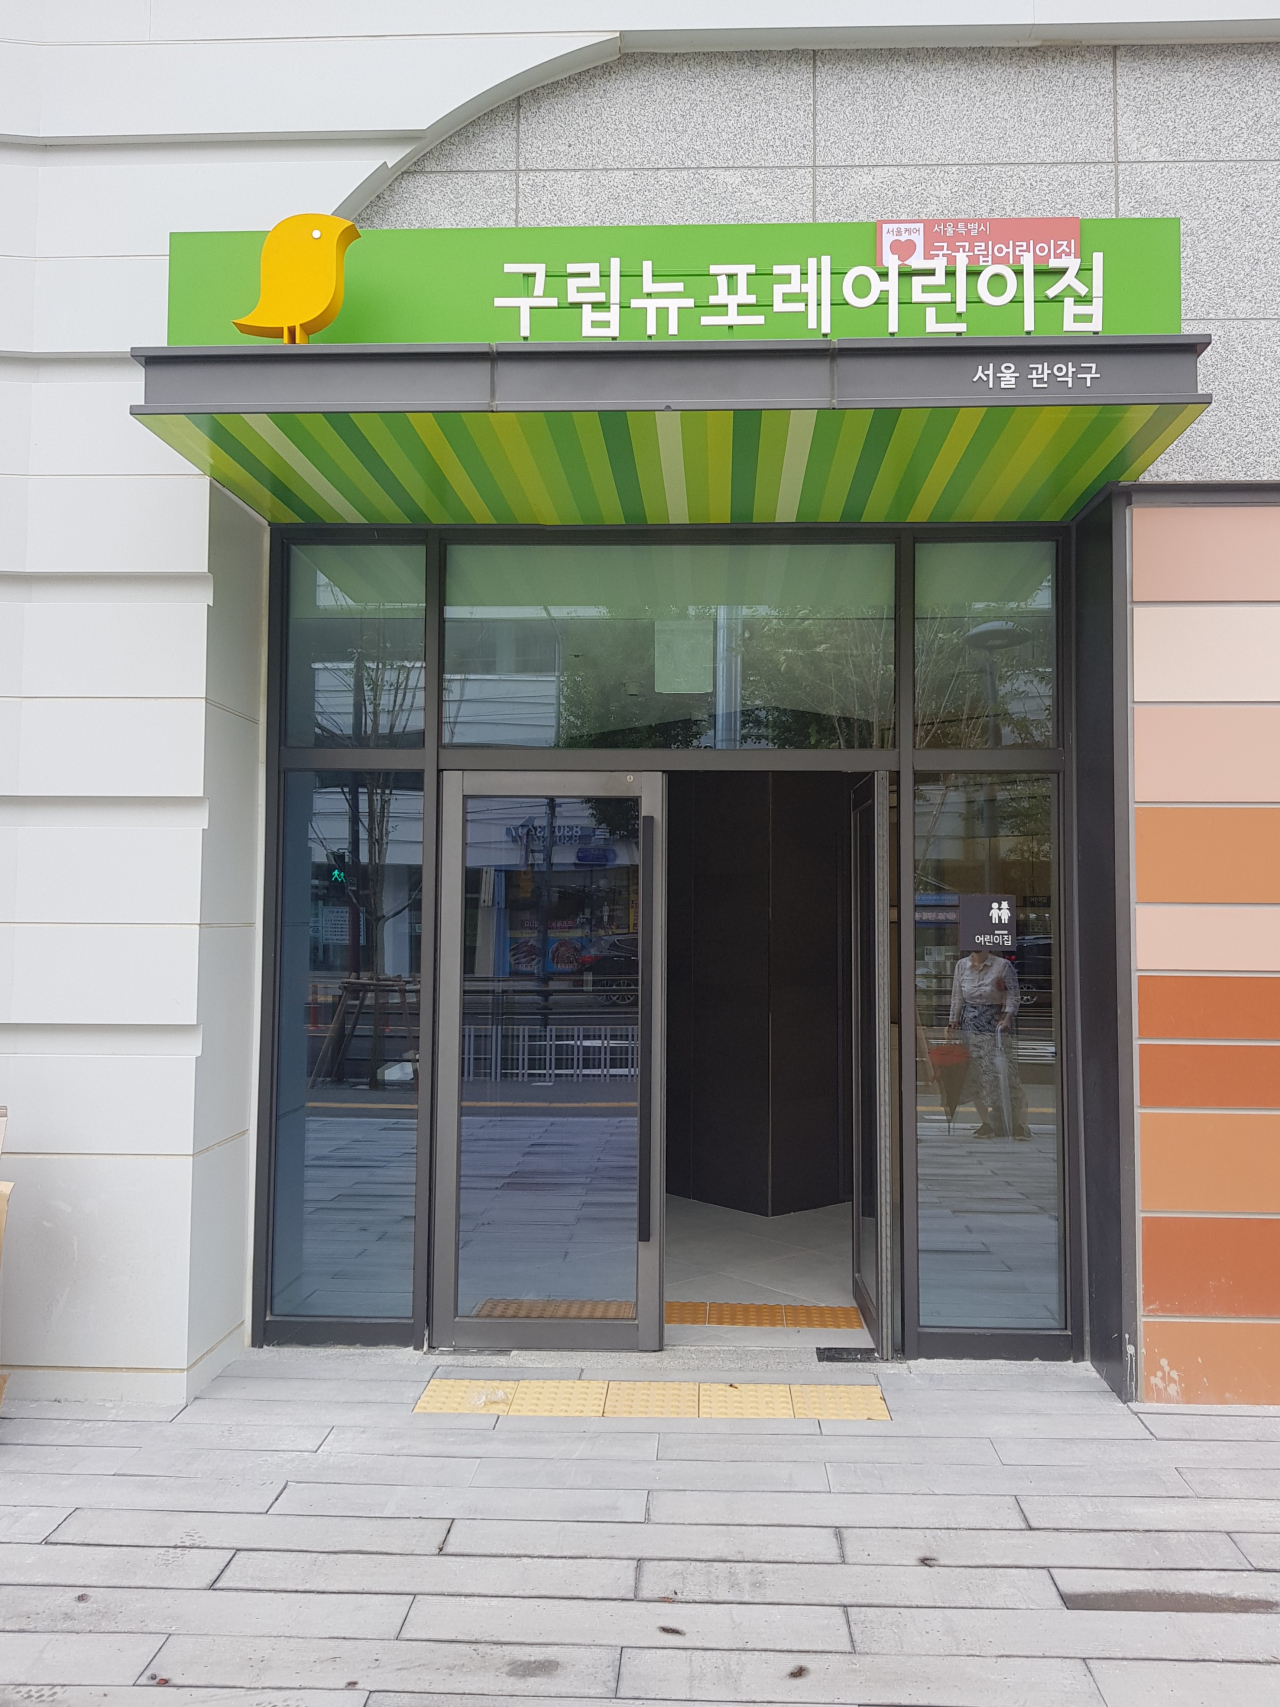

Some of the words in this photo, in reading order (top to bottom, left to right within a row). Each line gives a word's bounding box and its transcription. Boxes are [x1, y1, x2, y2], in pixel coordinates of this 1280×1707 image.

[885, 226, 921, 237] 서울케어
[932, 222, 990, 236] 서울특별시
[929, 238, 1076, 266] 국공립어린이집
[493, 251, 1104, 338] 구립뉴포레어린이집
[972, 362, 1020, 389] 서울
[1027, 361, 1101, 388] 관악구
[975, 934, 1012, 946] 어린이집
